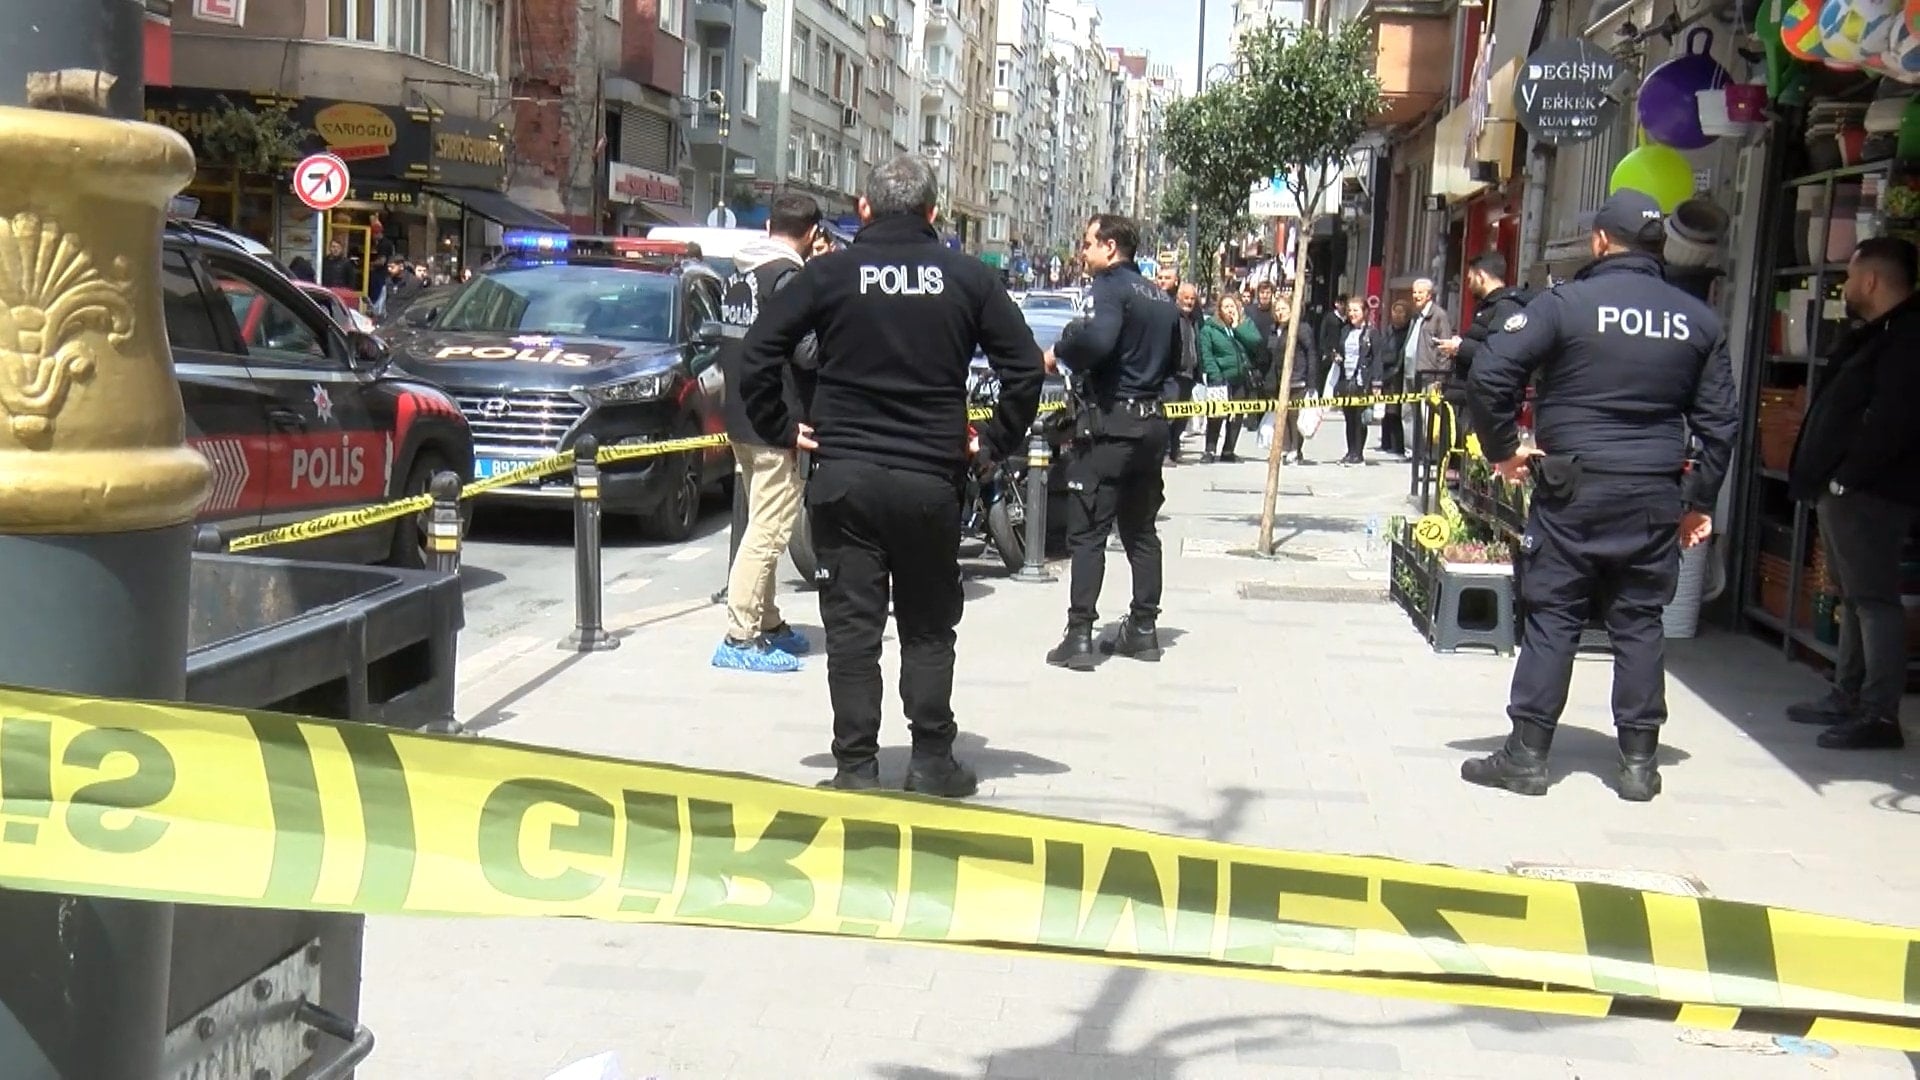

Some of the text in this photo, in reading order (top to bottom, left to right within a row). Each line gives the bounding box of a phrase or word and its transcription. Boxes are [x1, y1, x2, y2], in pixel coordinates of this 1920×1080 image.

[1528, 61, 1613, 82] DEĞİŞİM
[1598, 306, 1690, 341] POLİS
[435, 345, 590, 367] POLİS
[291, 434, 365, 489] POLİS
